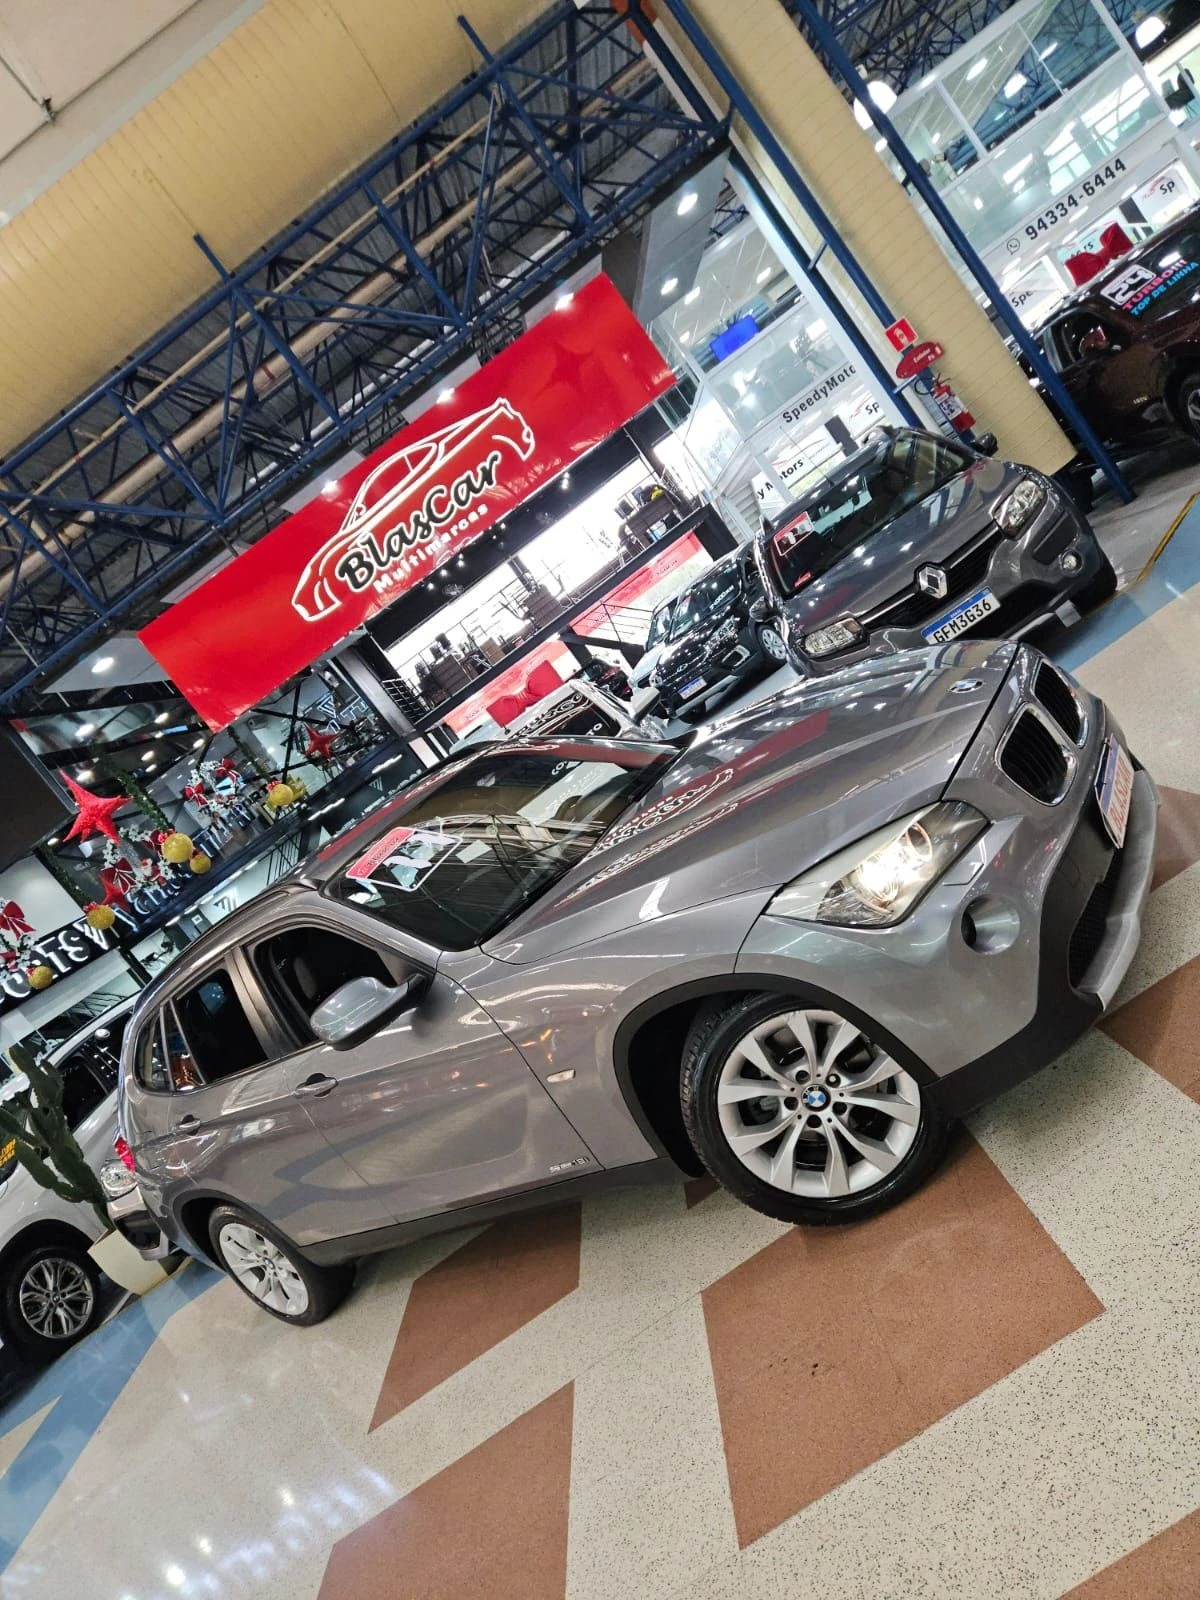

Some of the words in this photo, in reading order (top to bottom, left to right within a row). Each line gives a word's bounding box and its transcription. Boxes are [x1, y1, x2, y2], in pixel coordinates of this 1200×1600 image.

[1025, 158, 1126, 240] 94334-6444
[1130, 296, 1151, 315] TOP
[1166, 261, 1199, 287] LINHA
[335, 450, 502, 593] BlasCar
[373, 503, 489, 594] Multimarcas
